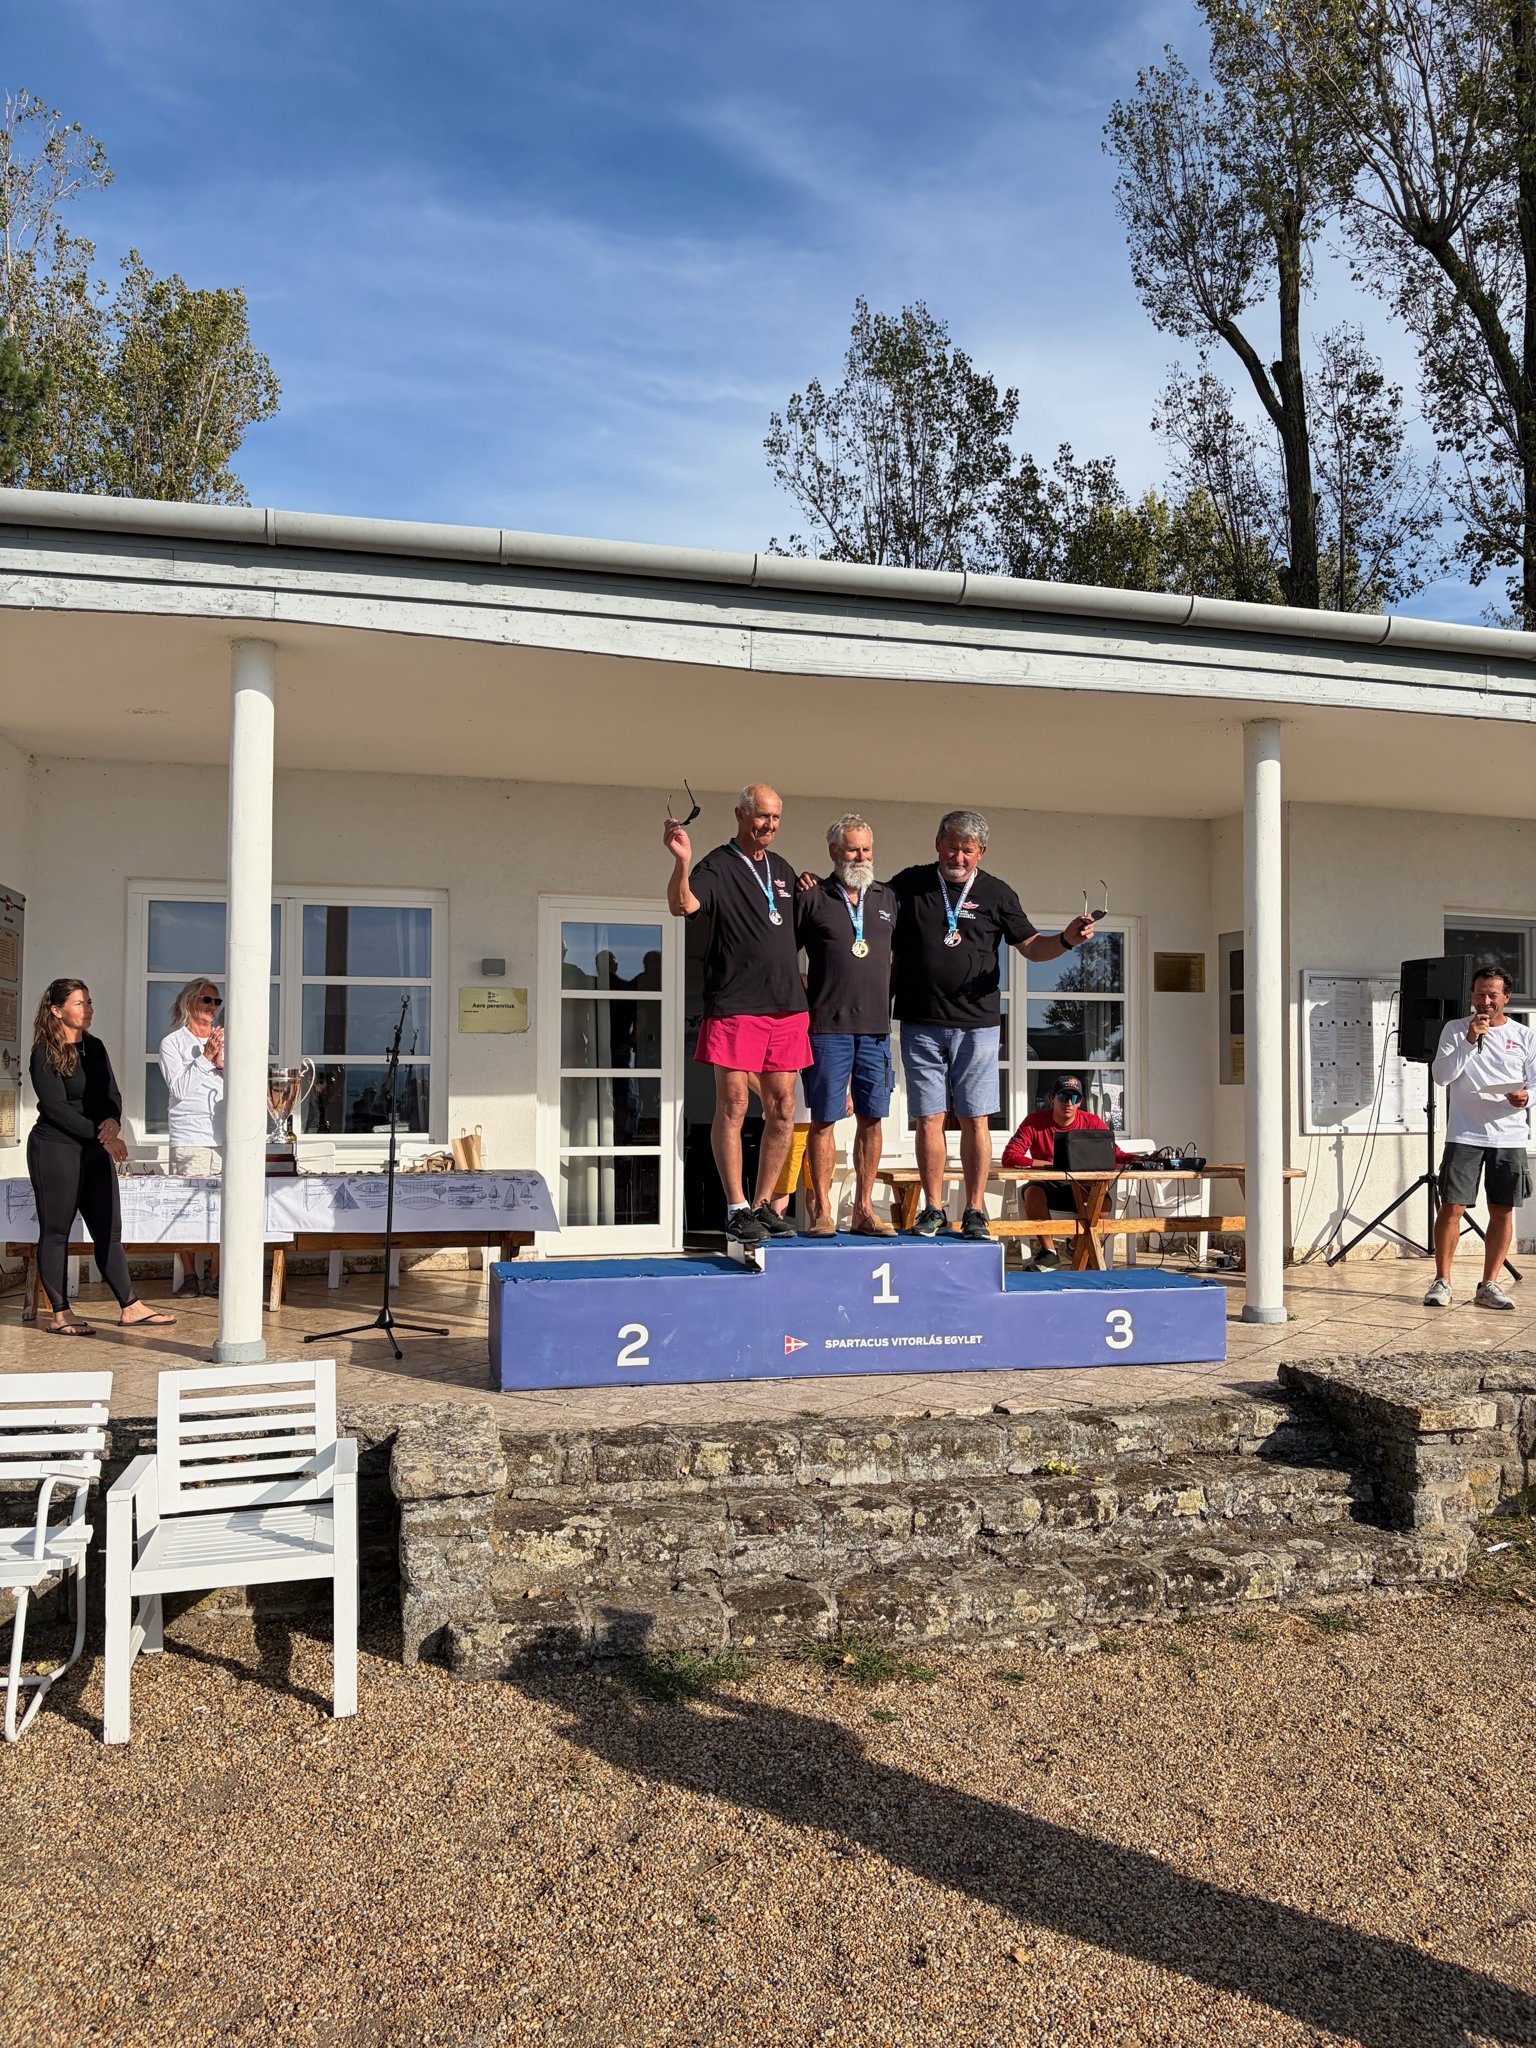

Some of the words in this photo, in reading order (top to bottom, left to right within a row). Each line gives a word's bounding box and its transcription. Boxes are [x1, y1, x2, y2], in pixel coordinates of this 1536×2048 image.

[872, 1263, 900, 1304] 1
[616, 1324, 650, 1367] 2
[825, 1337, 889, 1349] SPARTACUS
[891, 1334, 943, 1346] VITORLÁS
[944, 1335, 983, 1345] EGYLET
[1105, 1310, 1134, 1351] 3
